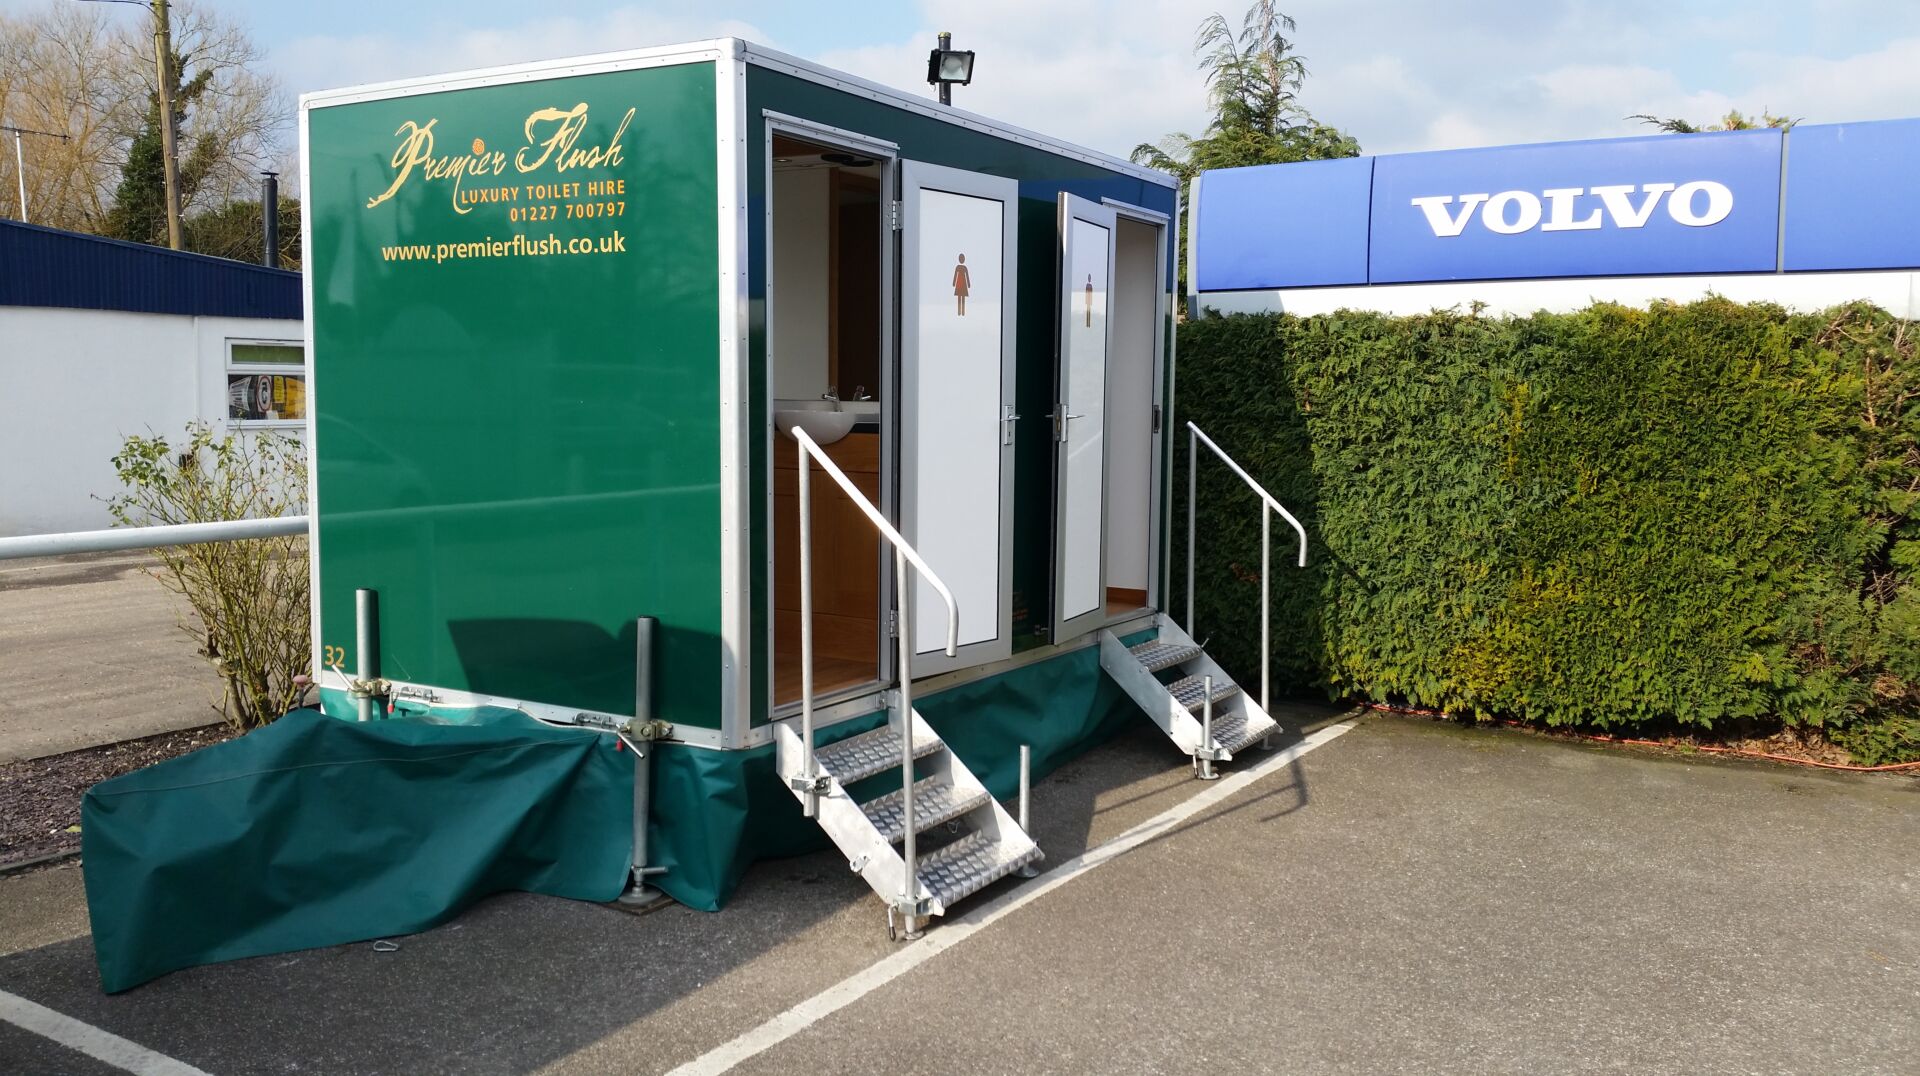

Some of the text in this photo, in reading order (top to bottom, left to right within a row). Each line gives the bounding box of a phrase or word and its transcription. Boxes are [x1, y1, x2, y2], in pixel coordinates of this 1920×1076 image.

[366, 102, 636, 214] Premier Flush
[461, 180, 625, 204] LUXURY TOILET HIRE
[510, 201, 626, 222] 01227 700797
[1411, 180, 1734, 237] VOLVO
[381, 230, 626, 264] www.premierflush.co.uk
[324, 644, 345, 668] 32
